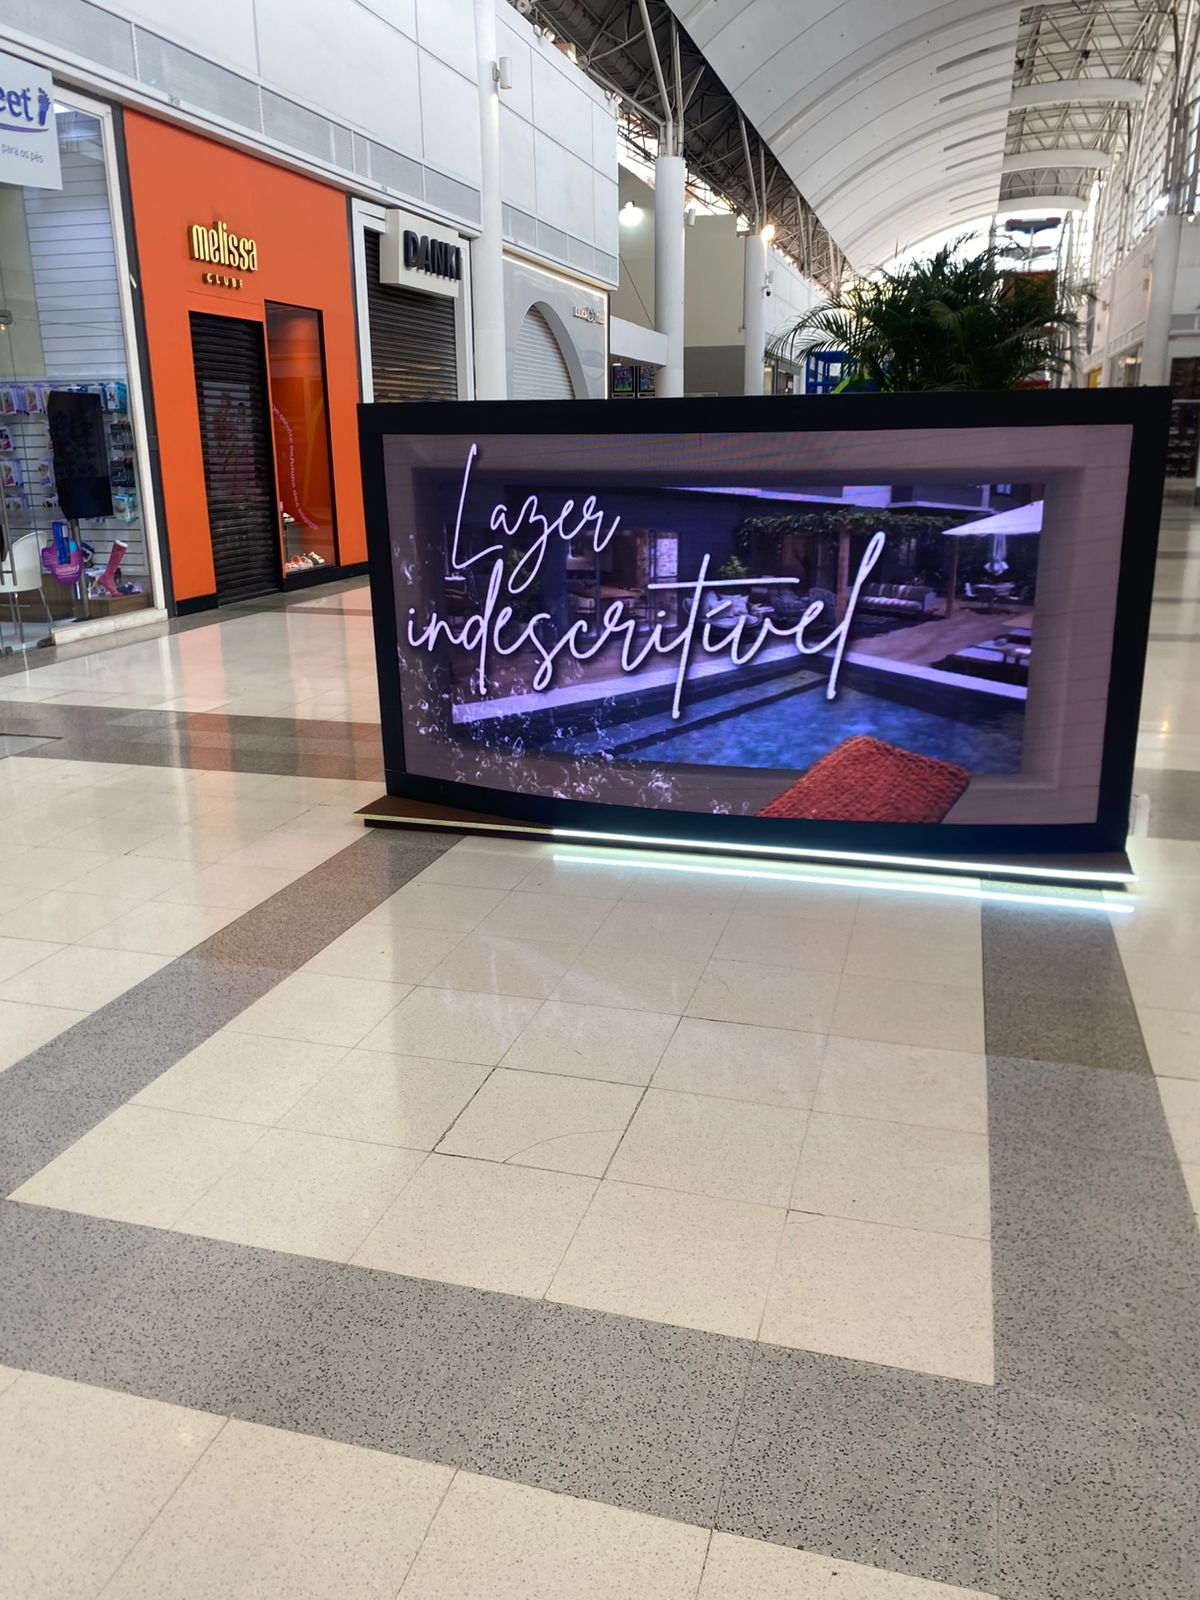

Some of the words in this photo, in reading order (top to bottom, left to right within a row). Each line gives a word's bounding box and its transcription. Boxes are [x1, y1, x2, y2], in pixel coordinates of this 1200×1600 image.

[1, 143, 19, 156] para
[190, 220, 258, 271] melissa
[403, 229, 462, 281] DANKI
[205, 272, 244, 289] CLUBE
[451, 443, 620, 594] Lazer
[407, 531, 886, 719] indescritível
